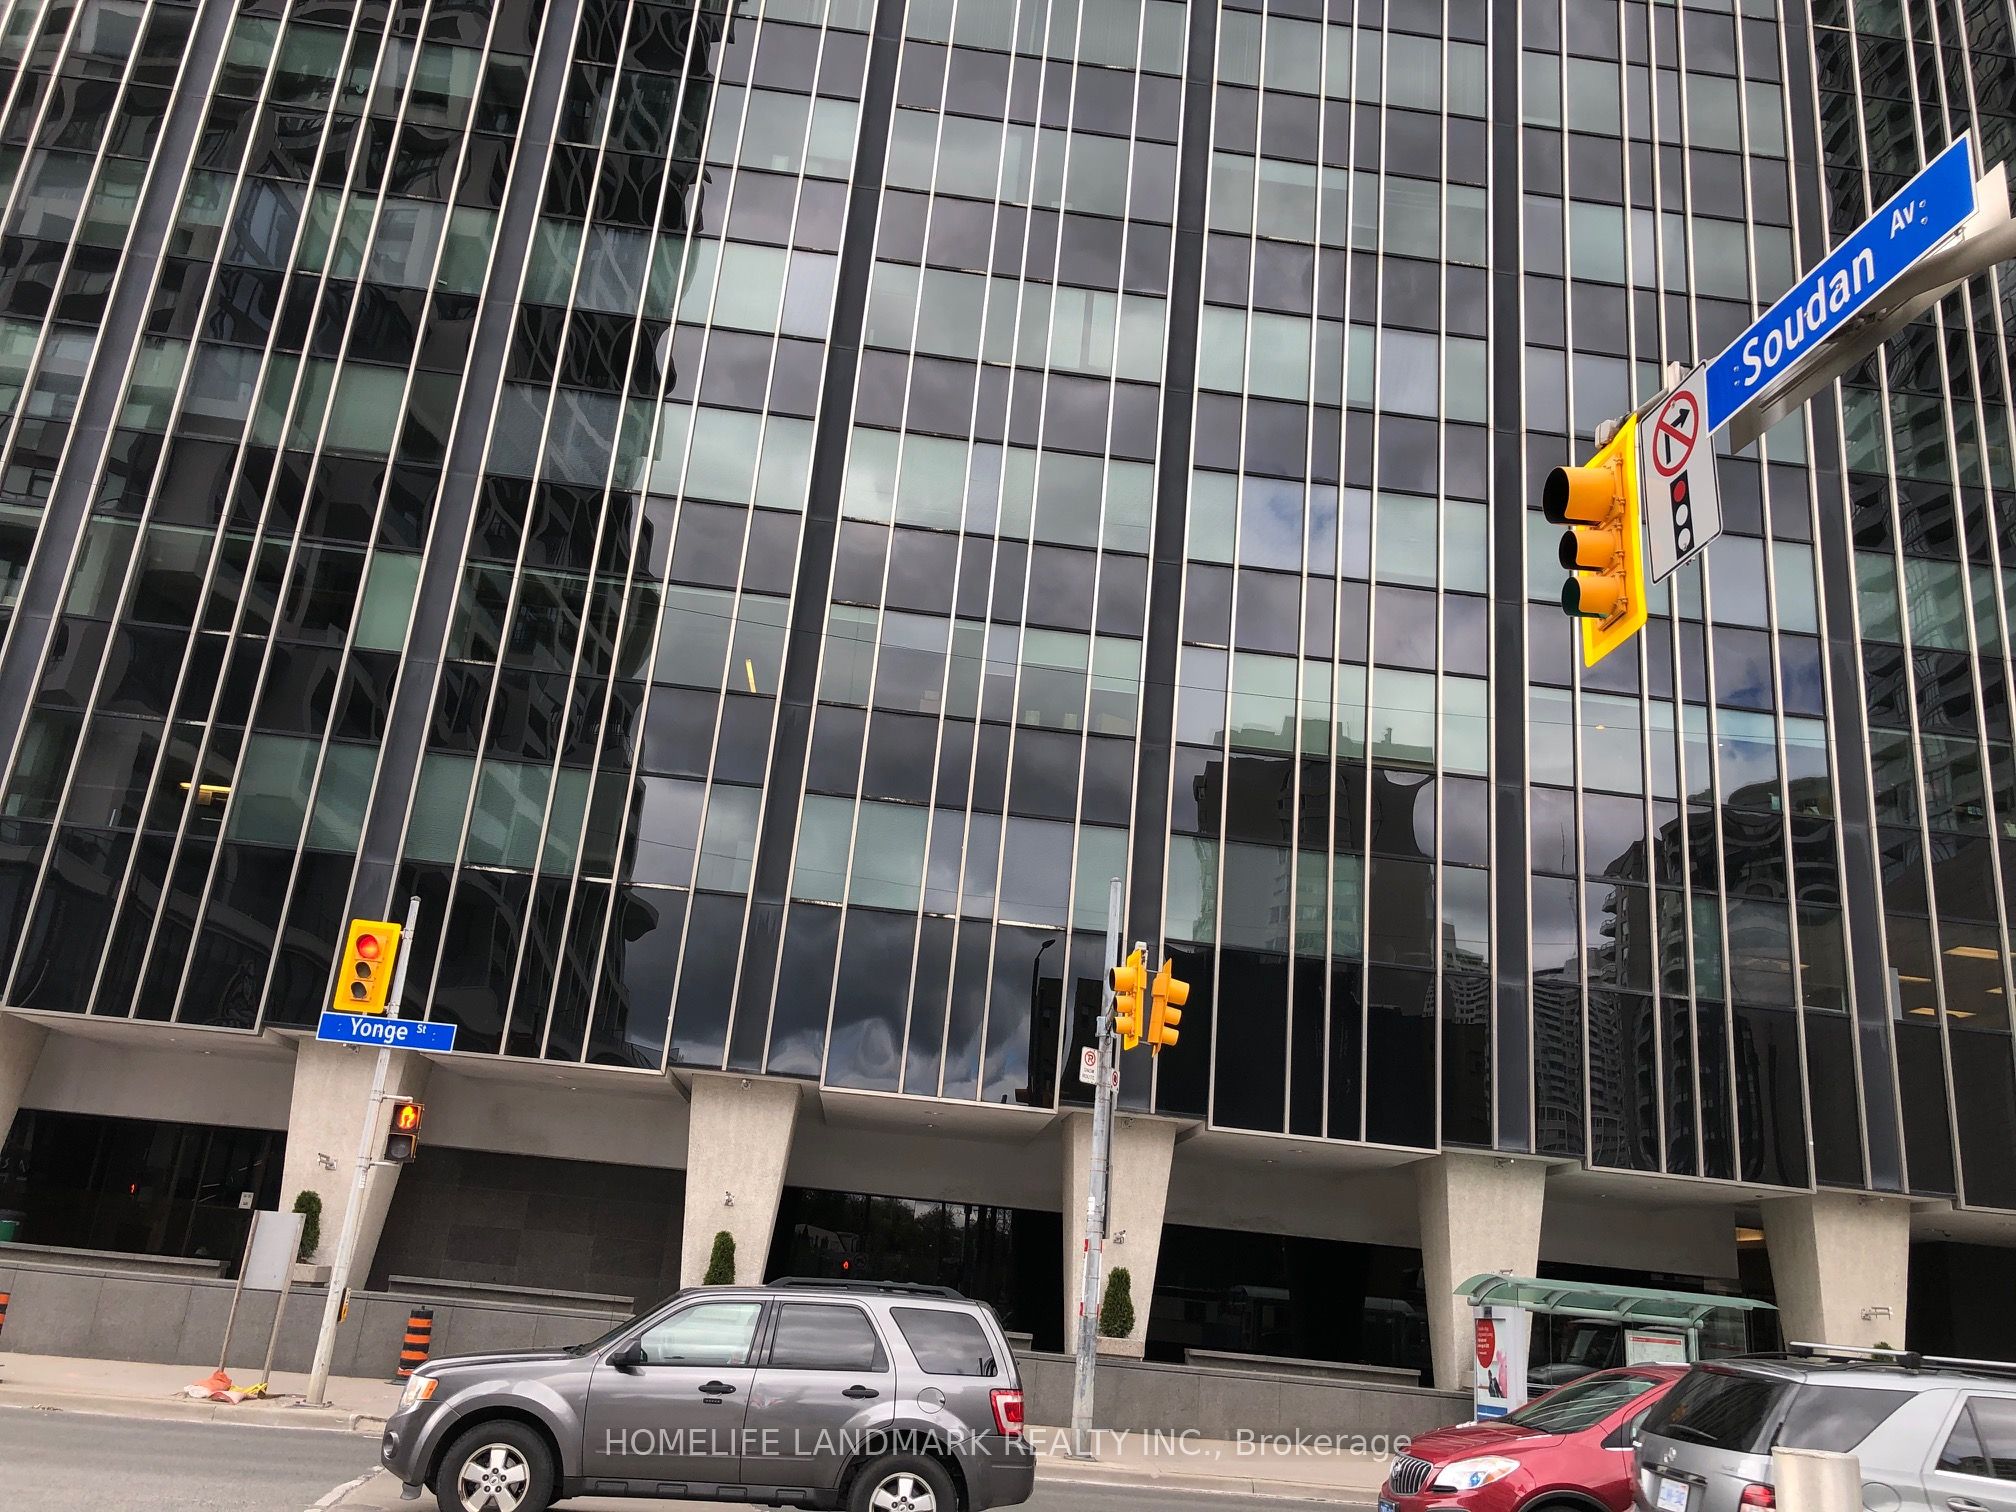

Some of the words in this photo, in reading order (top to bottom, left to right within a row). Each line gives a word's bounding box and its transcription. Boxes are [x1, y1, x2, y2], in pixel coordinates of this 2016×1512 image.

[1742, 247, 1875, 387] Soudan
[1890, 200, 1915, 240] Av
[350, 1017, 408, 1044] Yonge
[416, 1024, 427, 1035] St
